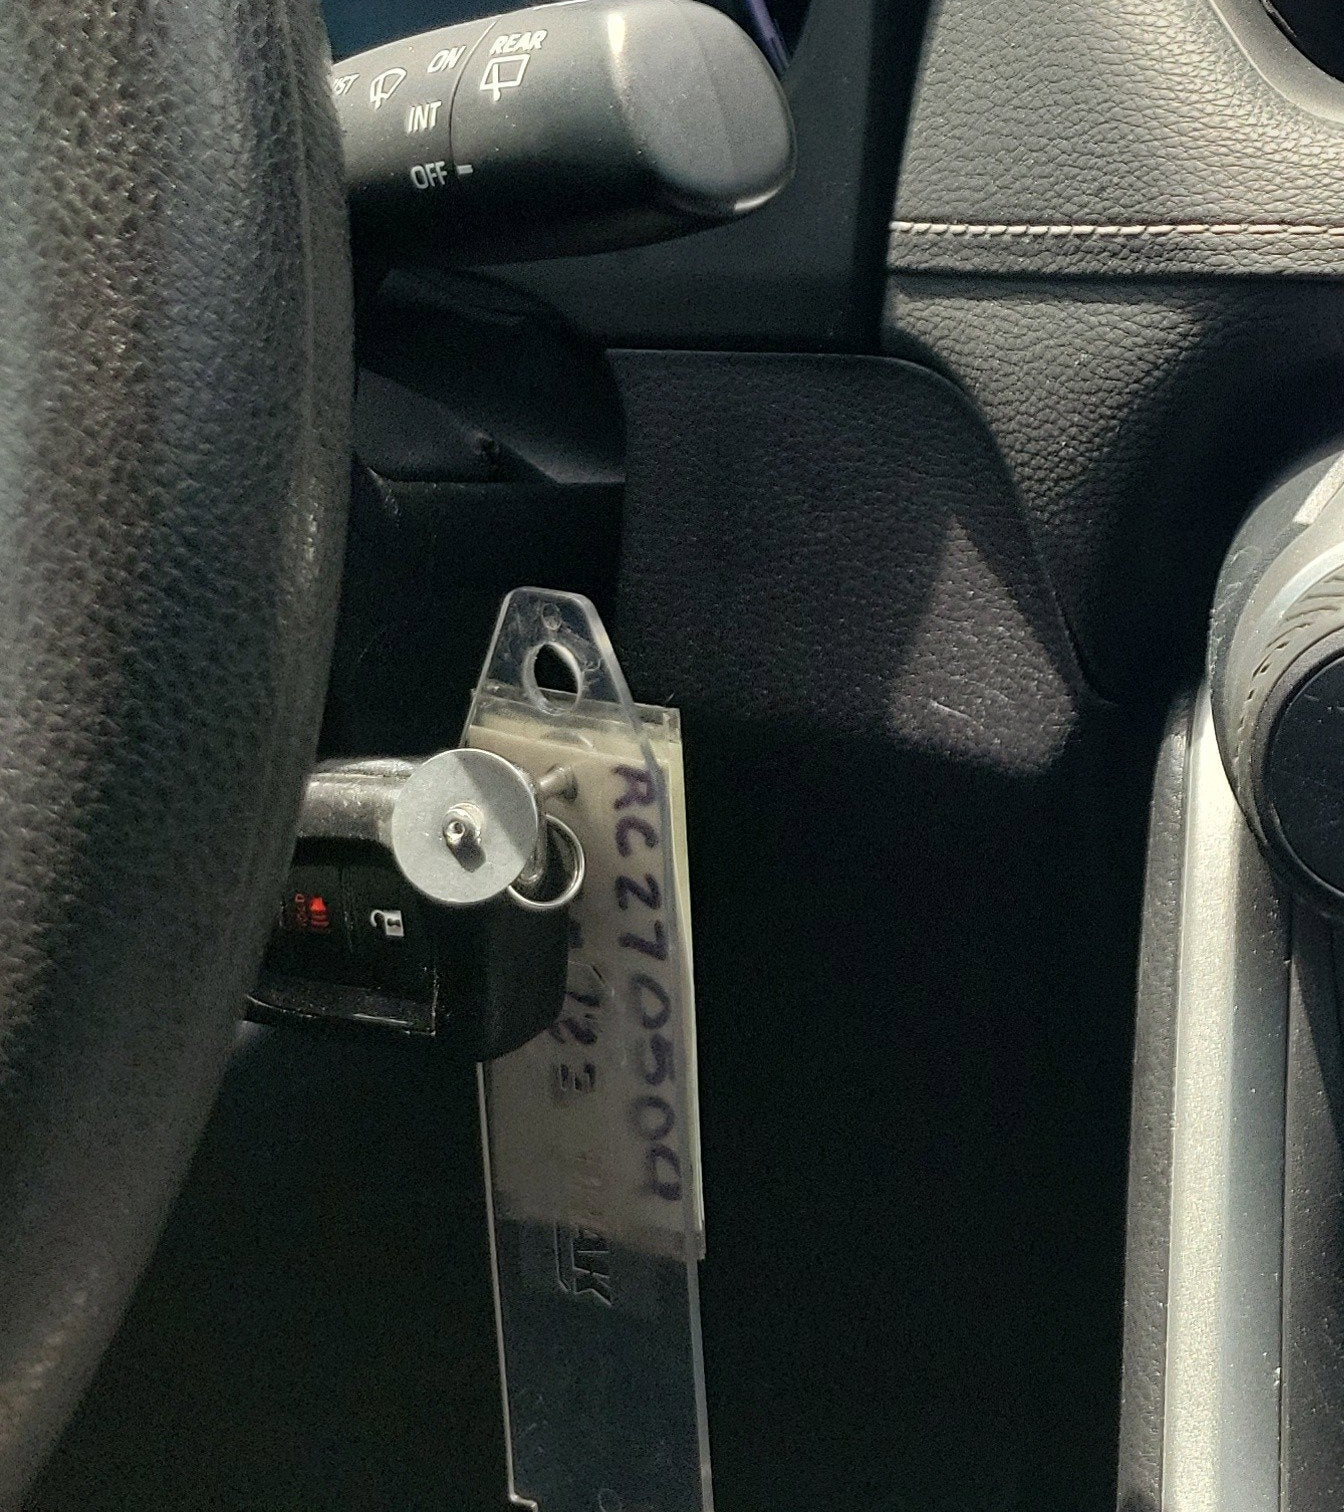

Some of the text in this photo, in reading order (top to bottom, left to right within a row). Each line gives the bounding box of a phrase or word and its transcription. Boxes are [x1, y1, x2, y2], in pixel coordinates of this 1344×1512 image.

[491, 29, 547, 54] REAR
[427, 46, 464, 73] ON
[406, 100, 442, 134] INT
[410, 161, 448, 190] OFF
